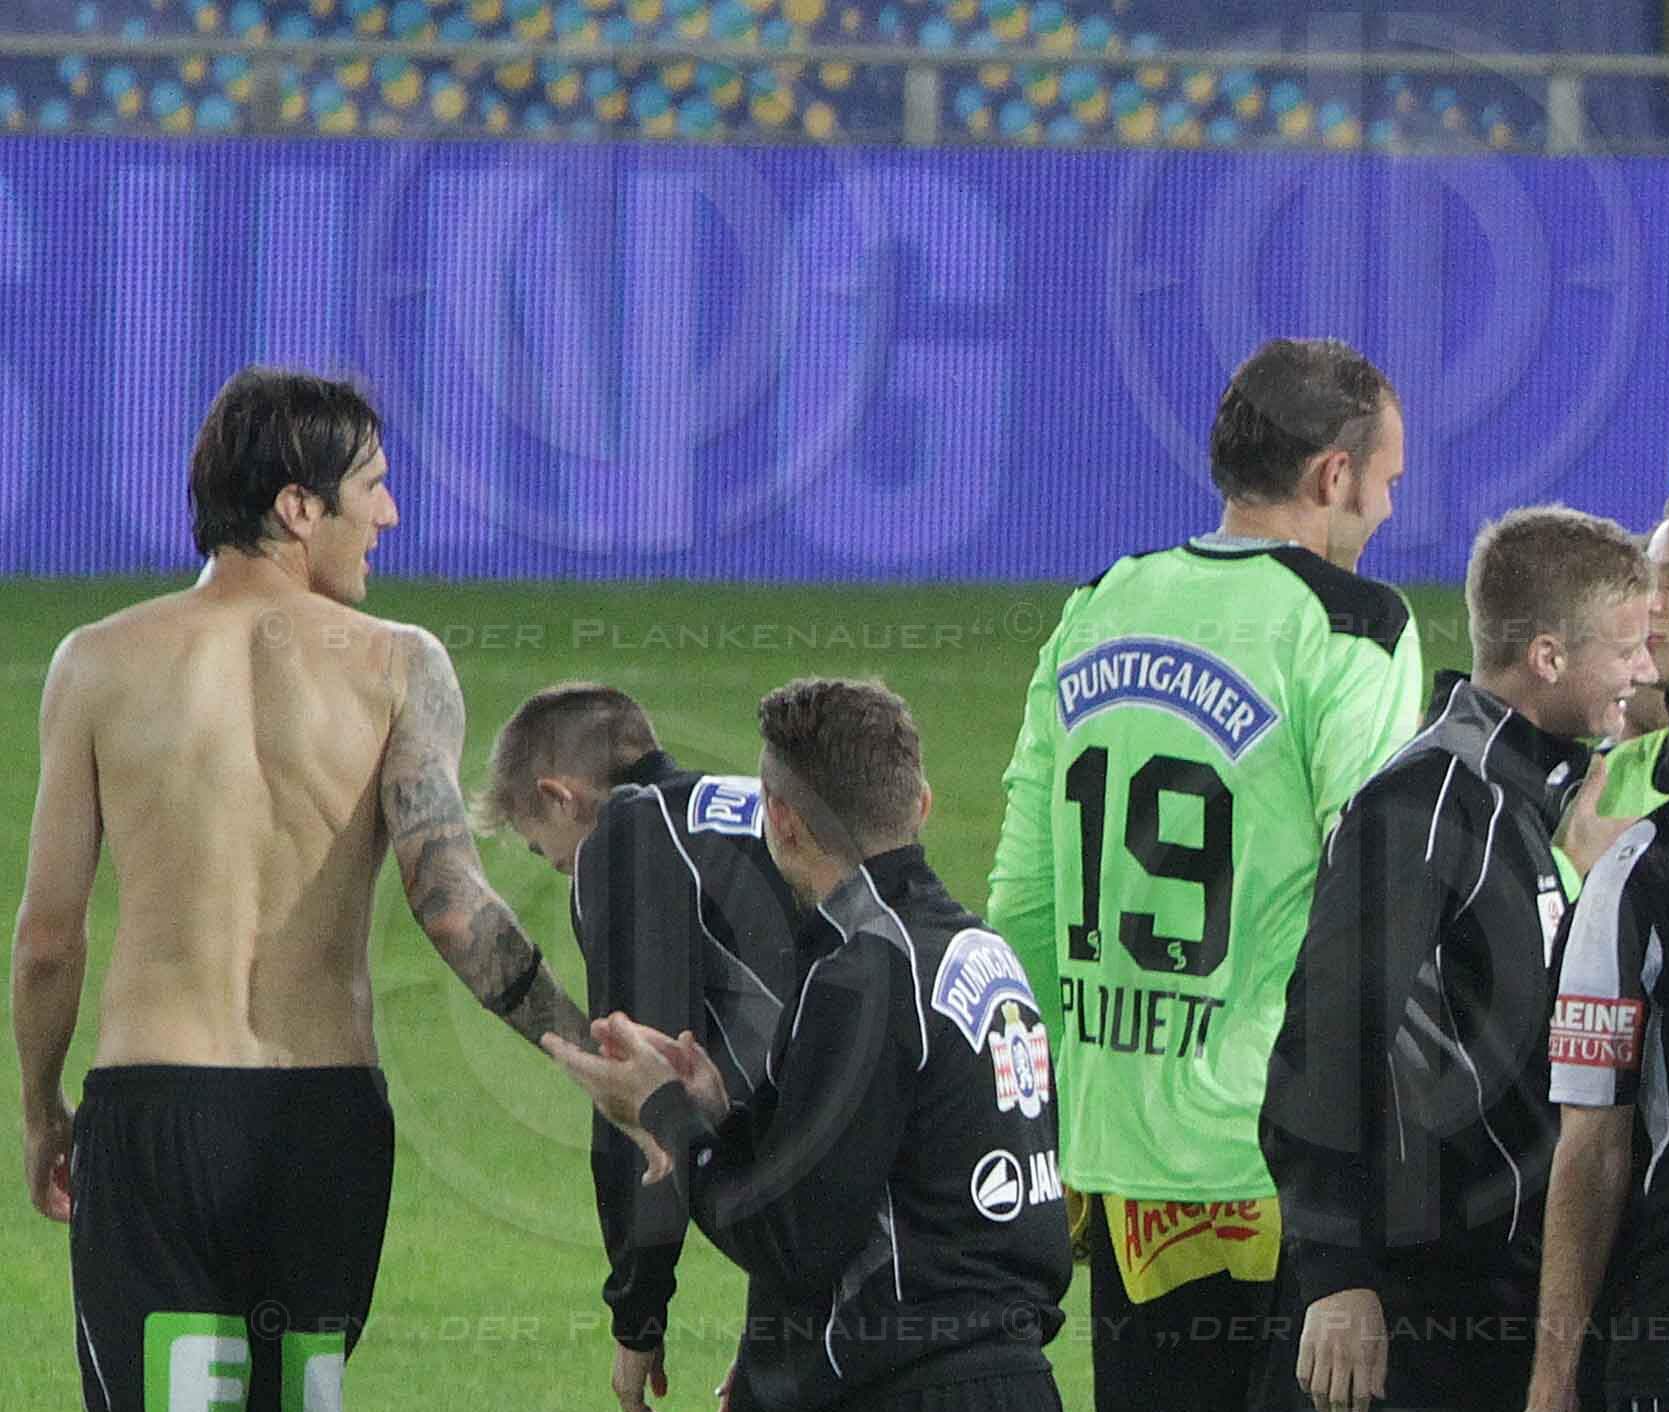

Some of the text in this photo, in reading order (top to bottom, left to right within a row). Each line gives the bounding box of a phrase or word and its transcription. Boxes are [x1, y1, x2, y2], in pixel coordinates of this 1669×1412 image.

[1060, 653, 1258, 740] PUNTIGAMER
[1064, 746, 1235, 978] 19
[1550, 1000, 1636, 1035] LEINE
